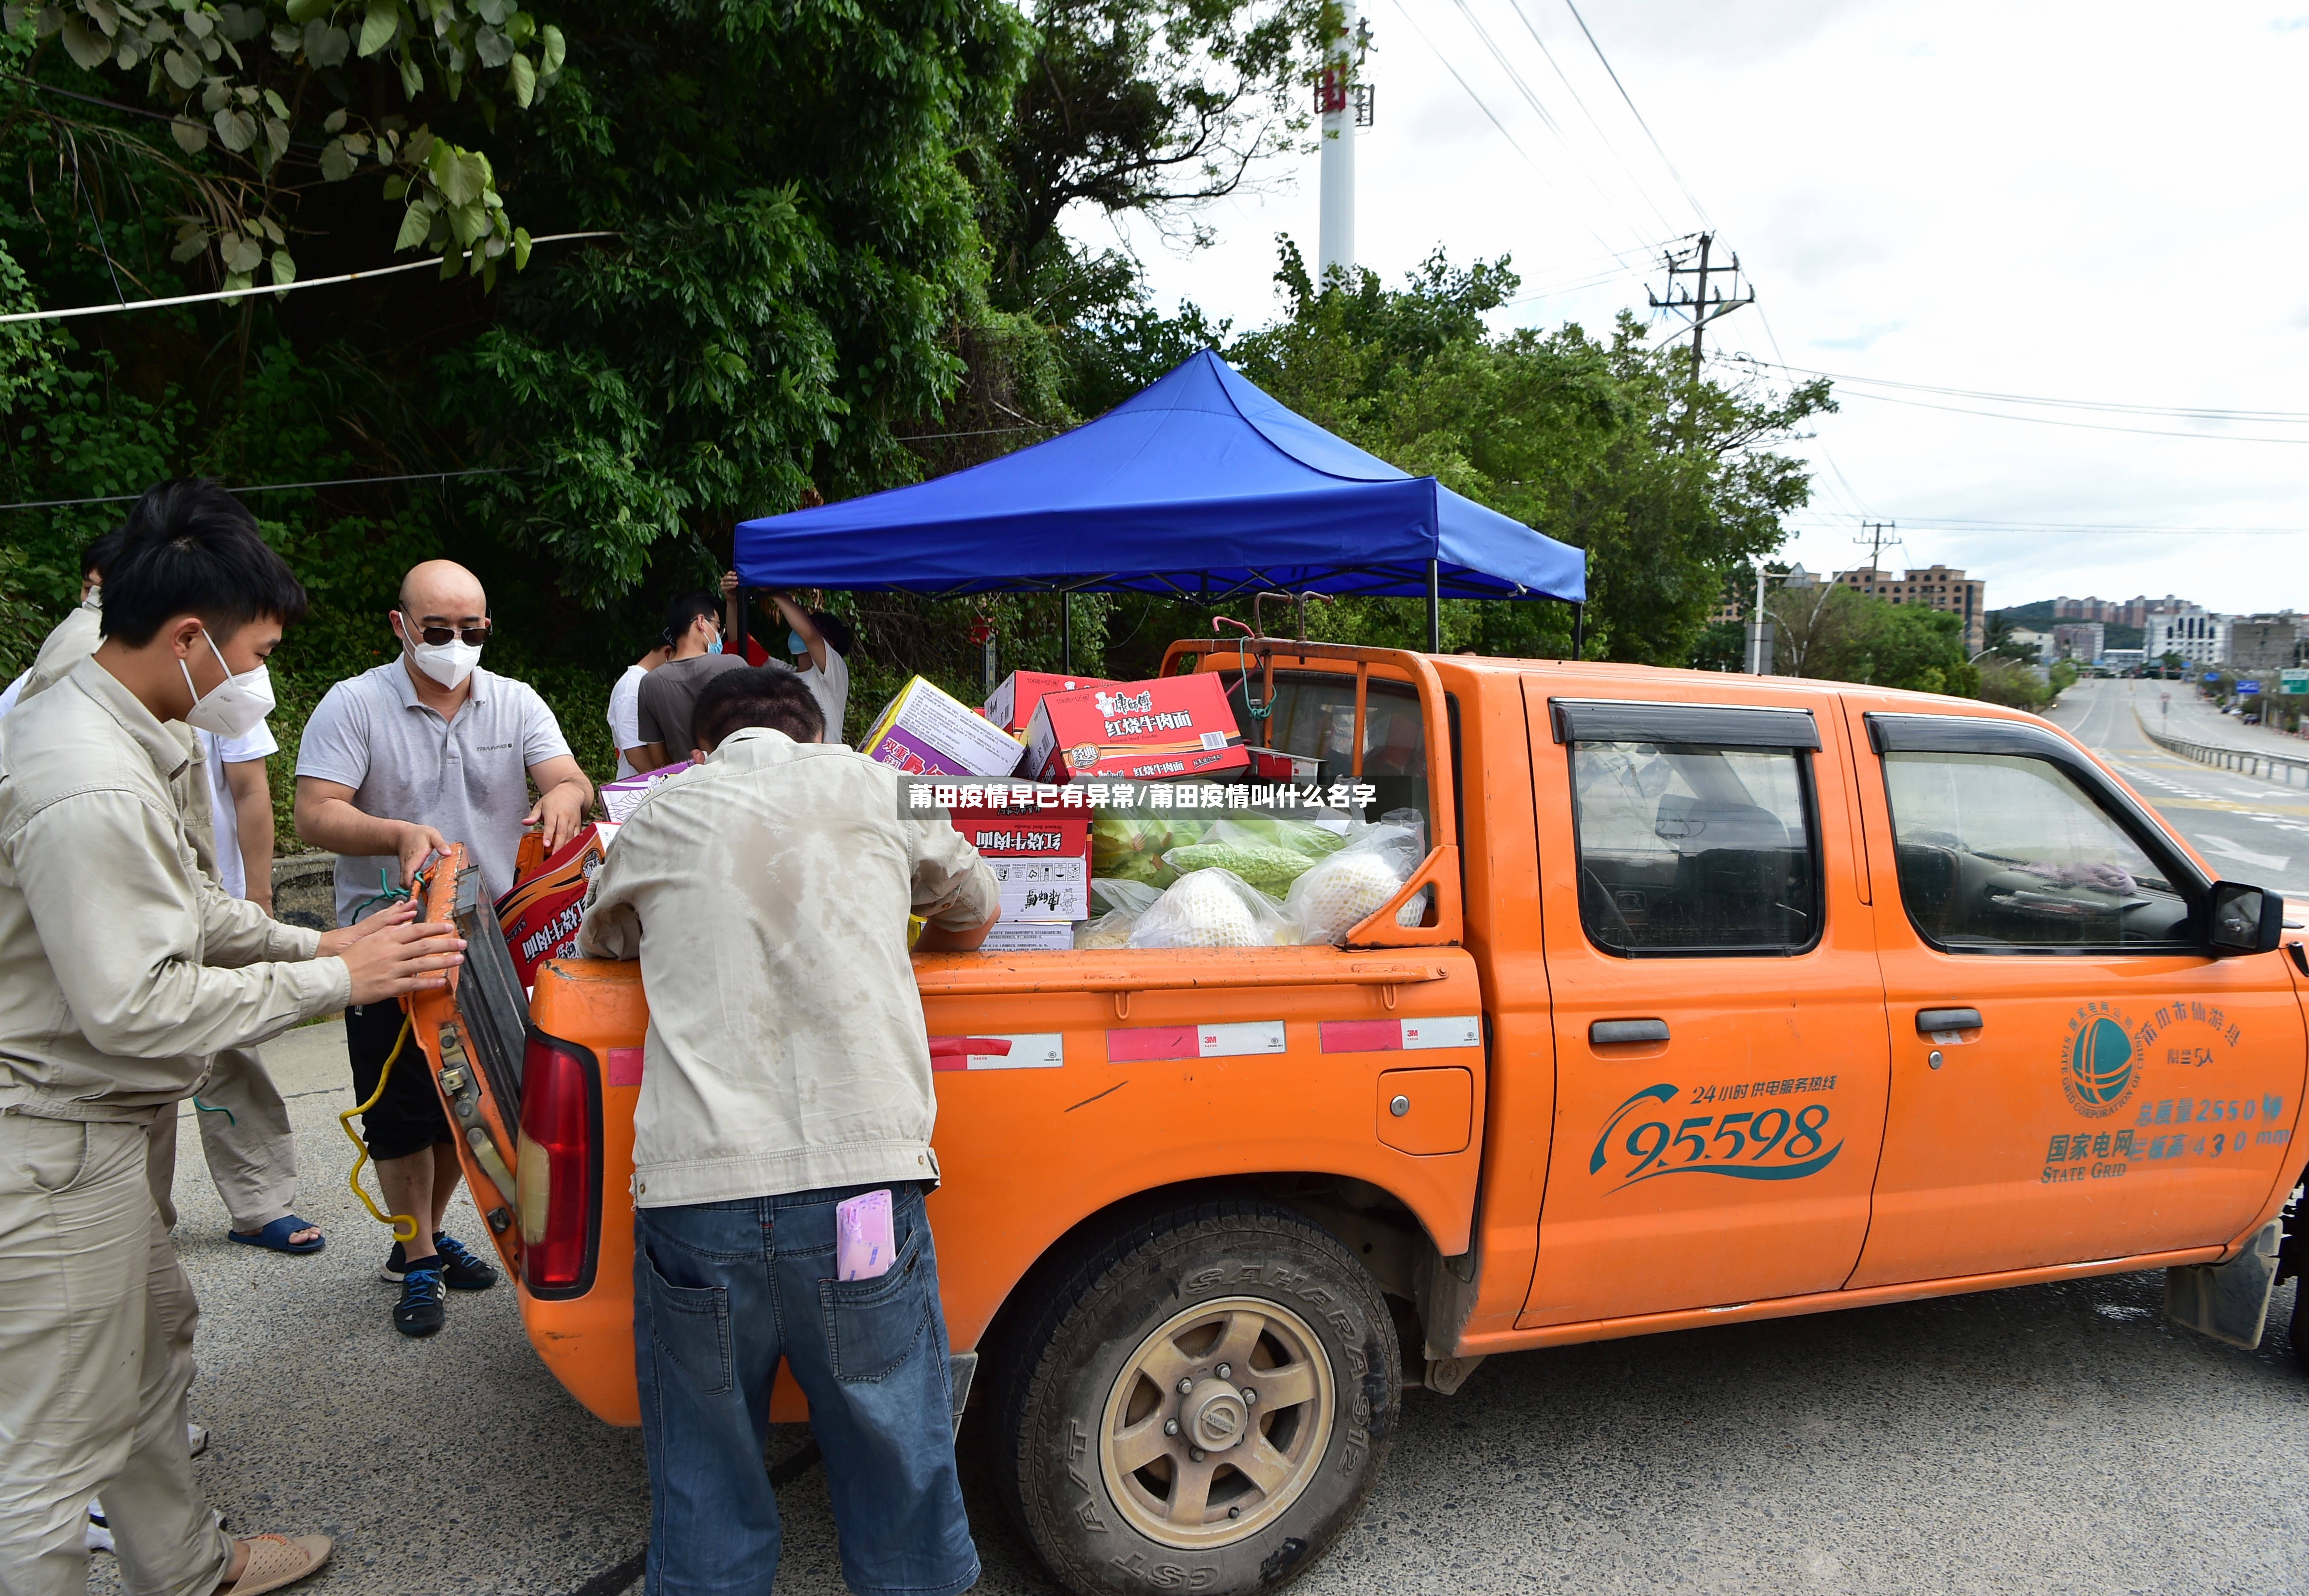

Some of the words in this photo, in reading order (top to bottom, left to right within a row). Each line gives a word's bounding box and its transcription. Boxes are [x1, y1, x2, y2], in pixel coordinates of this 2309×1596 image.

[1105, 710, 1193, 737] 红烧牛肉面
[884, 738, 909, 761] 双重
[1071, 746, 1098, 761] 经典
[1132, 761, 1184, 778] 红烧牛肉面
[975, 830, 1062, 851] 红烧牛肉面
[2061, 1036, 2071, 1074] STATE
[2135, 1032, 2145, 1070] CHINA
[1690, 1084, 1749, 1105] 24小时
[1751, 1075, 1837, 1098] 供电服务热线
[2061, 1077, 2076, 1104] GRID
[2131, 1073, 2141, 1088] OF
[2074, 1089, 2133, 1118] CORPORATION
[1625, 1104, 1830, 1178] 95598
[2046, 1129, 2135, 1163] 国家电网
[2041, 1166, 2086, 1184] STATE
[2091, 1161, 2127, 1179] GRID
[1185, 1264, 1369, 1381] SAHARA
[1336, 1394, 1370, 1476] 912
[1207, 1414, 1235, 1431] NISSAN
[1067, 1418, 1109, 1532] A/T
[1109, 1551, 1219, 1591] CST
